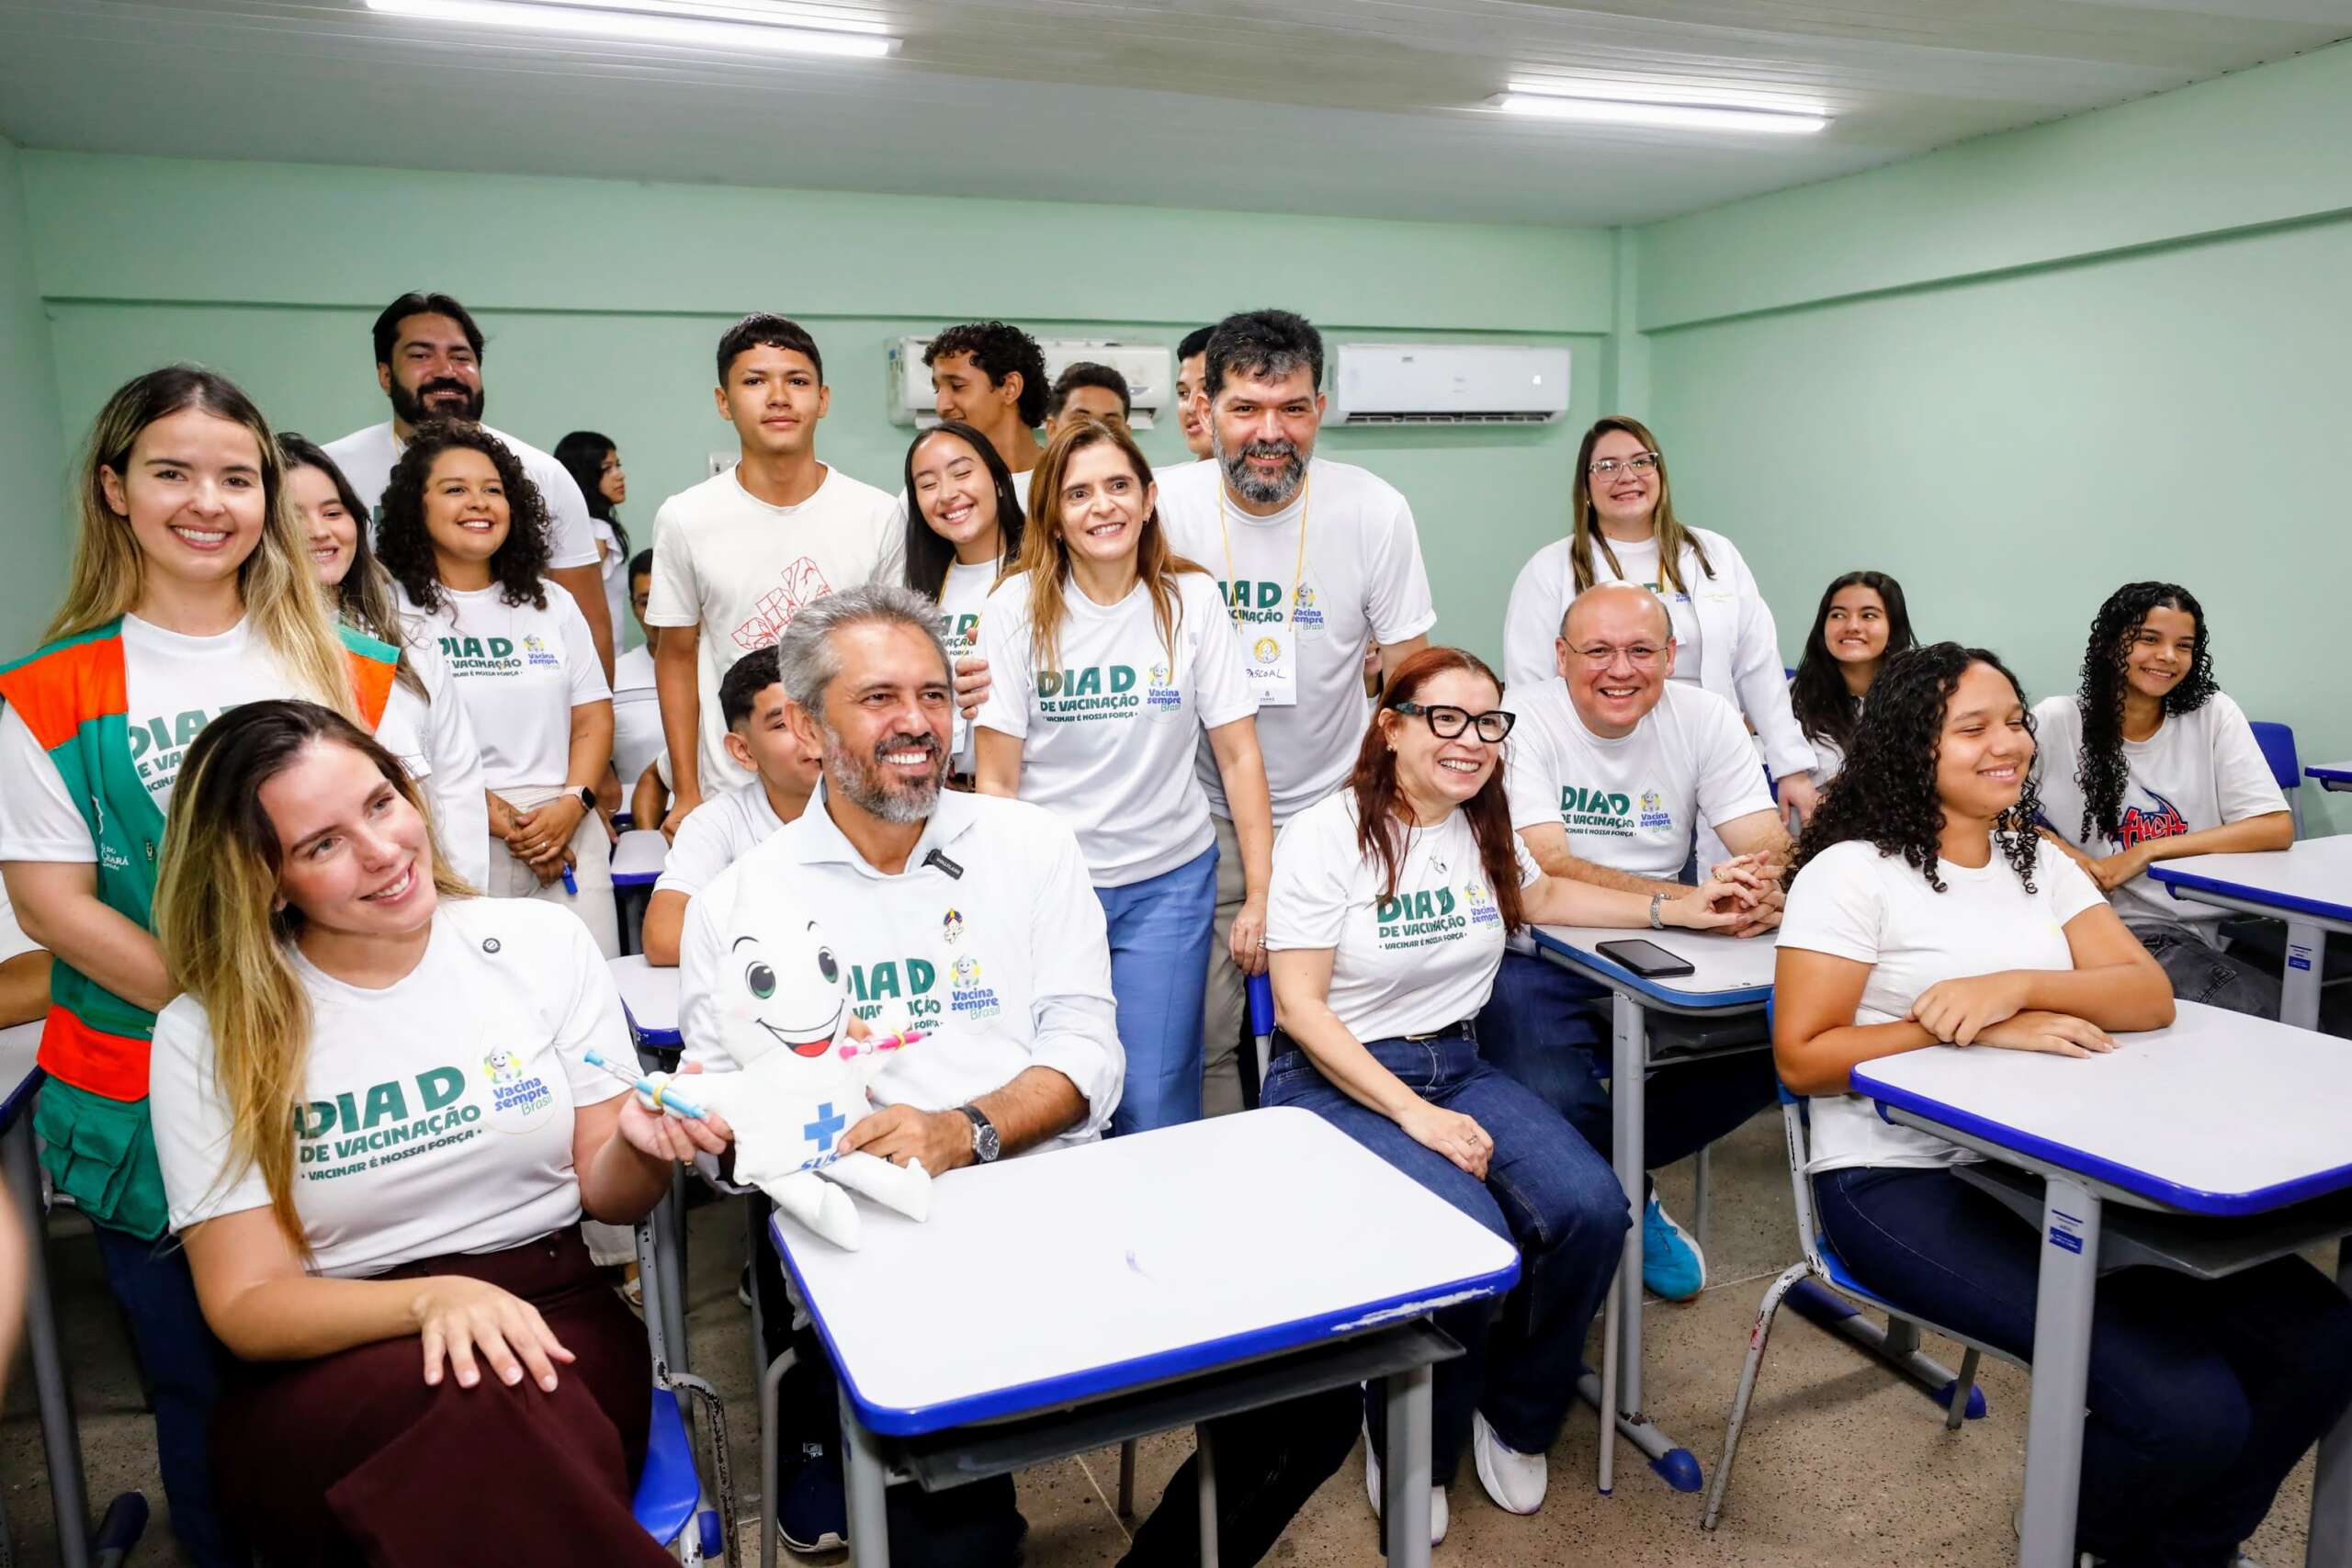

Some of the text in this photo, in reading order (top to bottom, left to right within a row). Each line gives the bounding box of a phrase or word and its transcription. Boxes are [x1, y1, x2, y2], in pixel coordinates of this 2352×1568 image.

[1217, 580, 1283, 609] IA D
[1228, 609, 1283, 624] CINAÇÃO
[1292, 615, 1324, 625] empre
[487, 637, 514, 659] D
[452, 658, 522, 671] VACINAÇÃO
[1037, 664, 1136, 698] DIA D
[1040, 693, 1140, 713] DE VACINAÇÃO
[1147, 696, 1182, 706] sempre
[1148, 688, 1180, 697] Vacina
[1076, 712, 1081, 722] É
[1083, 712, 1108, 721] NOSSA
[1108, 710, 1134, 719] FORÇA
[130, 709, 209, 761] DIA
[1560, 785, 1631, 817] DIA D
[1641, 811, 1668, 821] Vacina
[1375, 886, 1455, 923] DIA D
[1379, 926, 1400, 938] DE
[1402, 915, 1466, 936] VACINAÇÃO
[1385, 941, 1419, 950] VACINAR
[1419, 938, 1425, 946] É
[1443, 932, 1464, 942] FORÇA
[847, 958, 935, 1001] IA D
[951, 997, 1000, 1011] sempre
[952, 987, 994, 1002] Vacina
[970, 1005, 1001, 1021] Brasil
[492, 1077, 542, 1099] Vacina
[494, 1085, 549, 1111] sempre
[294, 1066, 466, 1140] DIA D
[521, 1092, 553, 1117] Brasil
[300, 1104, 481, 1164] DE VACINAÇÃO
[309, 1129, 474, 1181] VACINAR É NOSSA FORÇA
